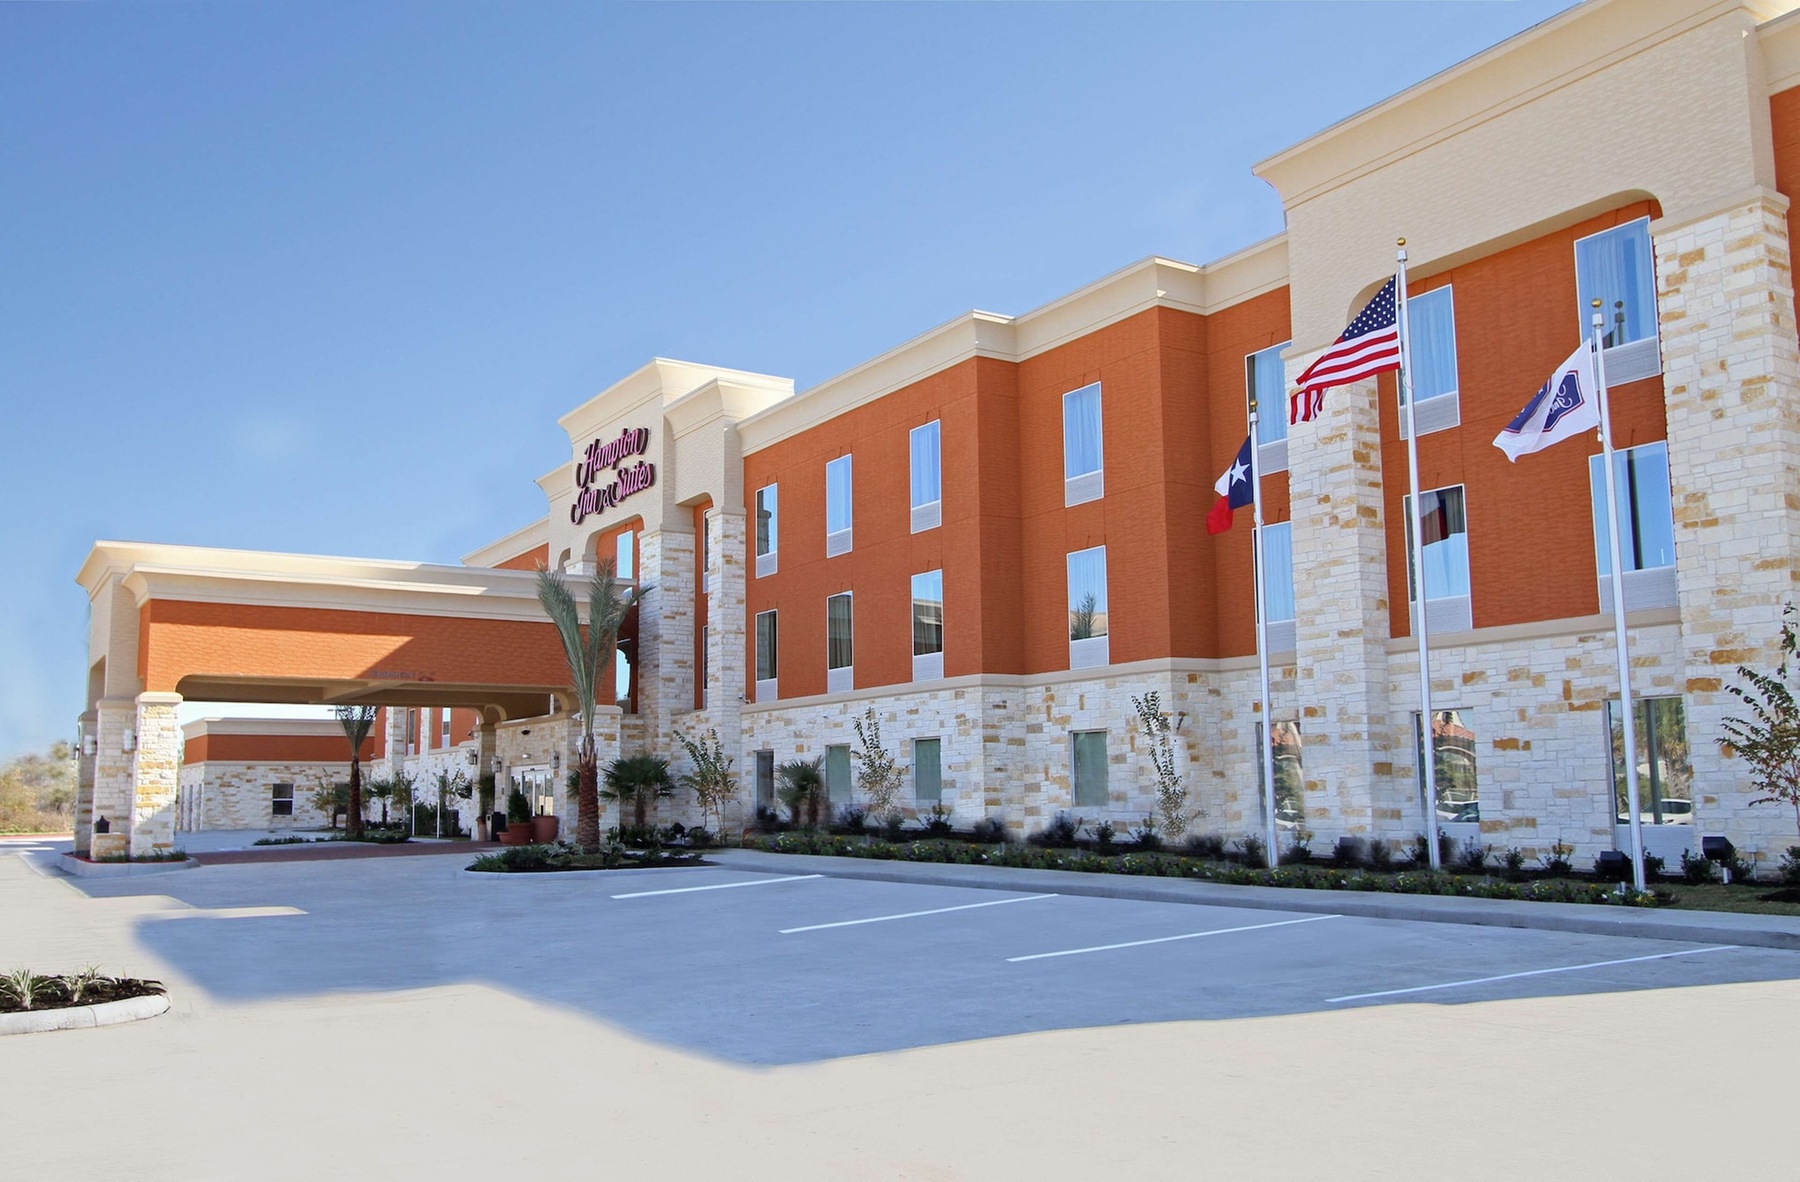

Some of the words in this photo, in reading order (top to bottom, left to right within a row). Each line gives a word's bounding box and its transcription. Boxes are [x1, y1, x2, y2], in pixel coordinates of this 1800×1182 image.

[576, 428, 648, 488] Hampton
[570, 486, 606, 525] Inn
[612, 460, 655, 502] Suites
